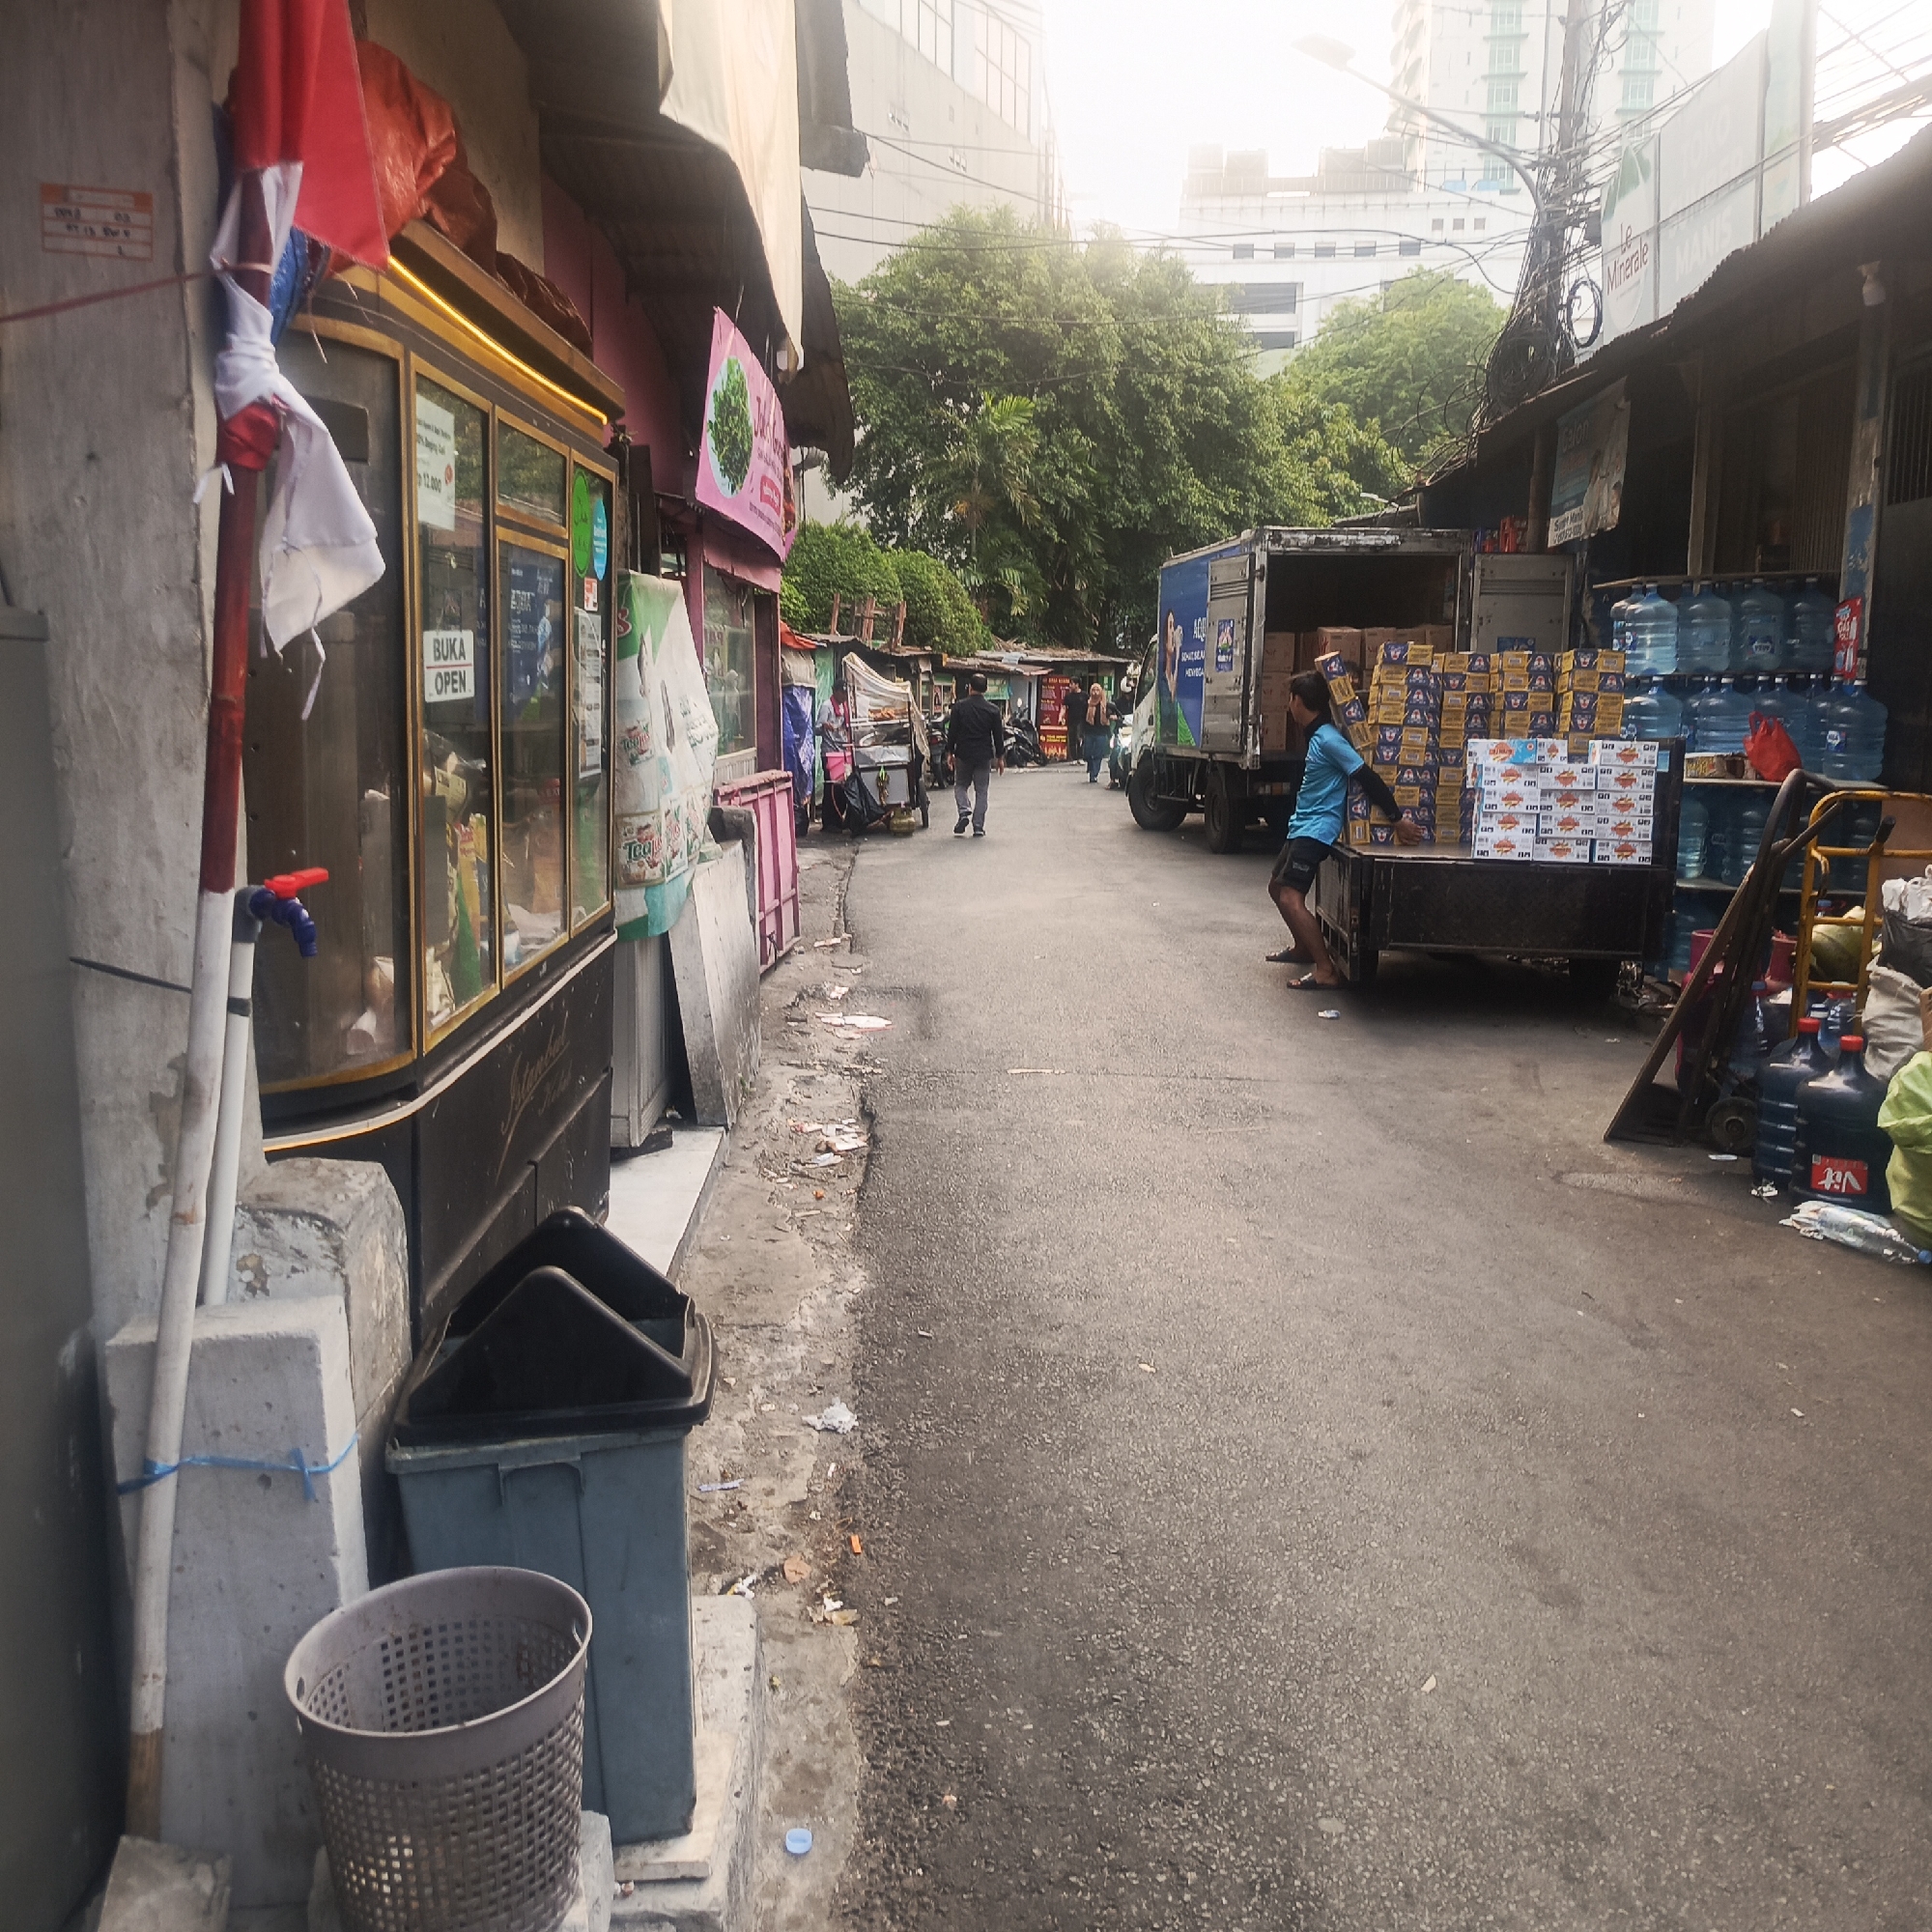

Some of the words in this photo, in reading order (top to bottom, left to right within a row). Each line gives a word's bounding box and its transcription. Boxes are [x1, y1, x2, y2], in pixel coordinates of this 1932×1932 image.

[1620, 222, 1633, 255] Le
[1675, 206, 1733, 283] MANIS
[1605, 237, 1649, 296] Minerale
[433, 638, 467, 662] BUKA
[435, 669, 467, 695] OPEN
[1818, 1167, 1861, 1193] Vit
